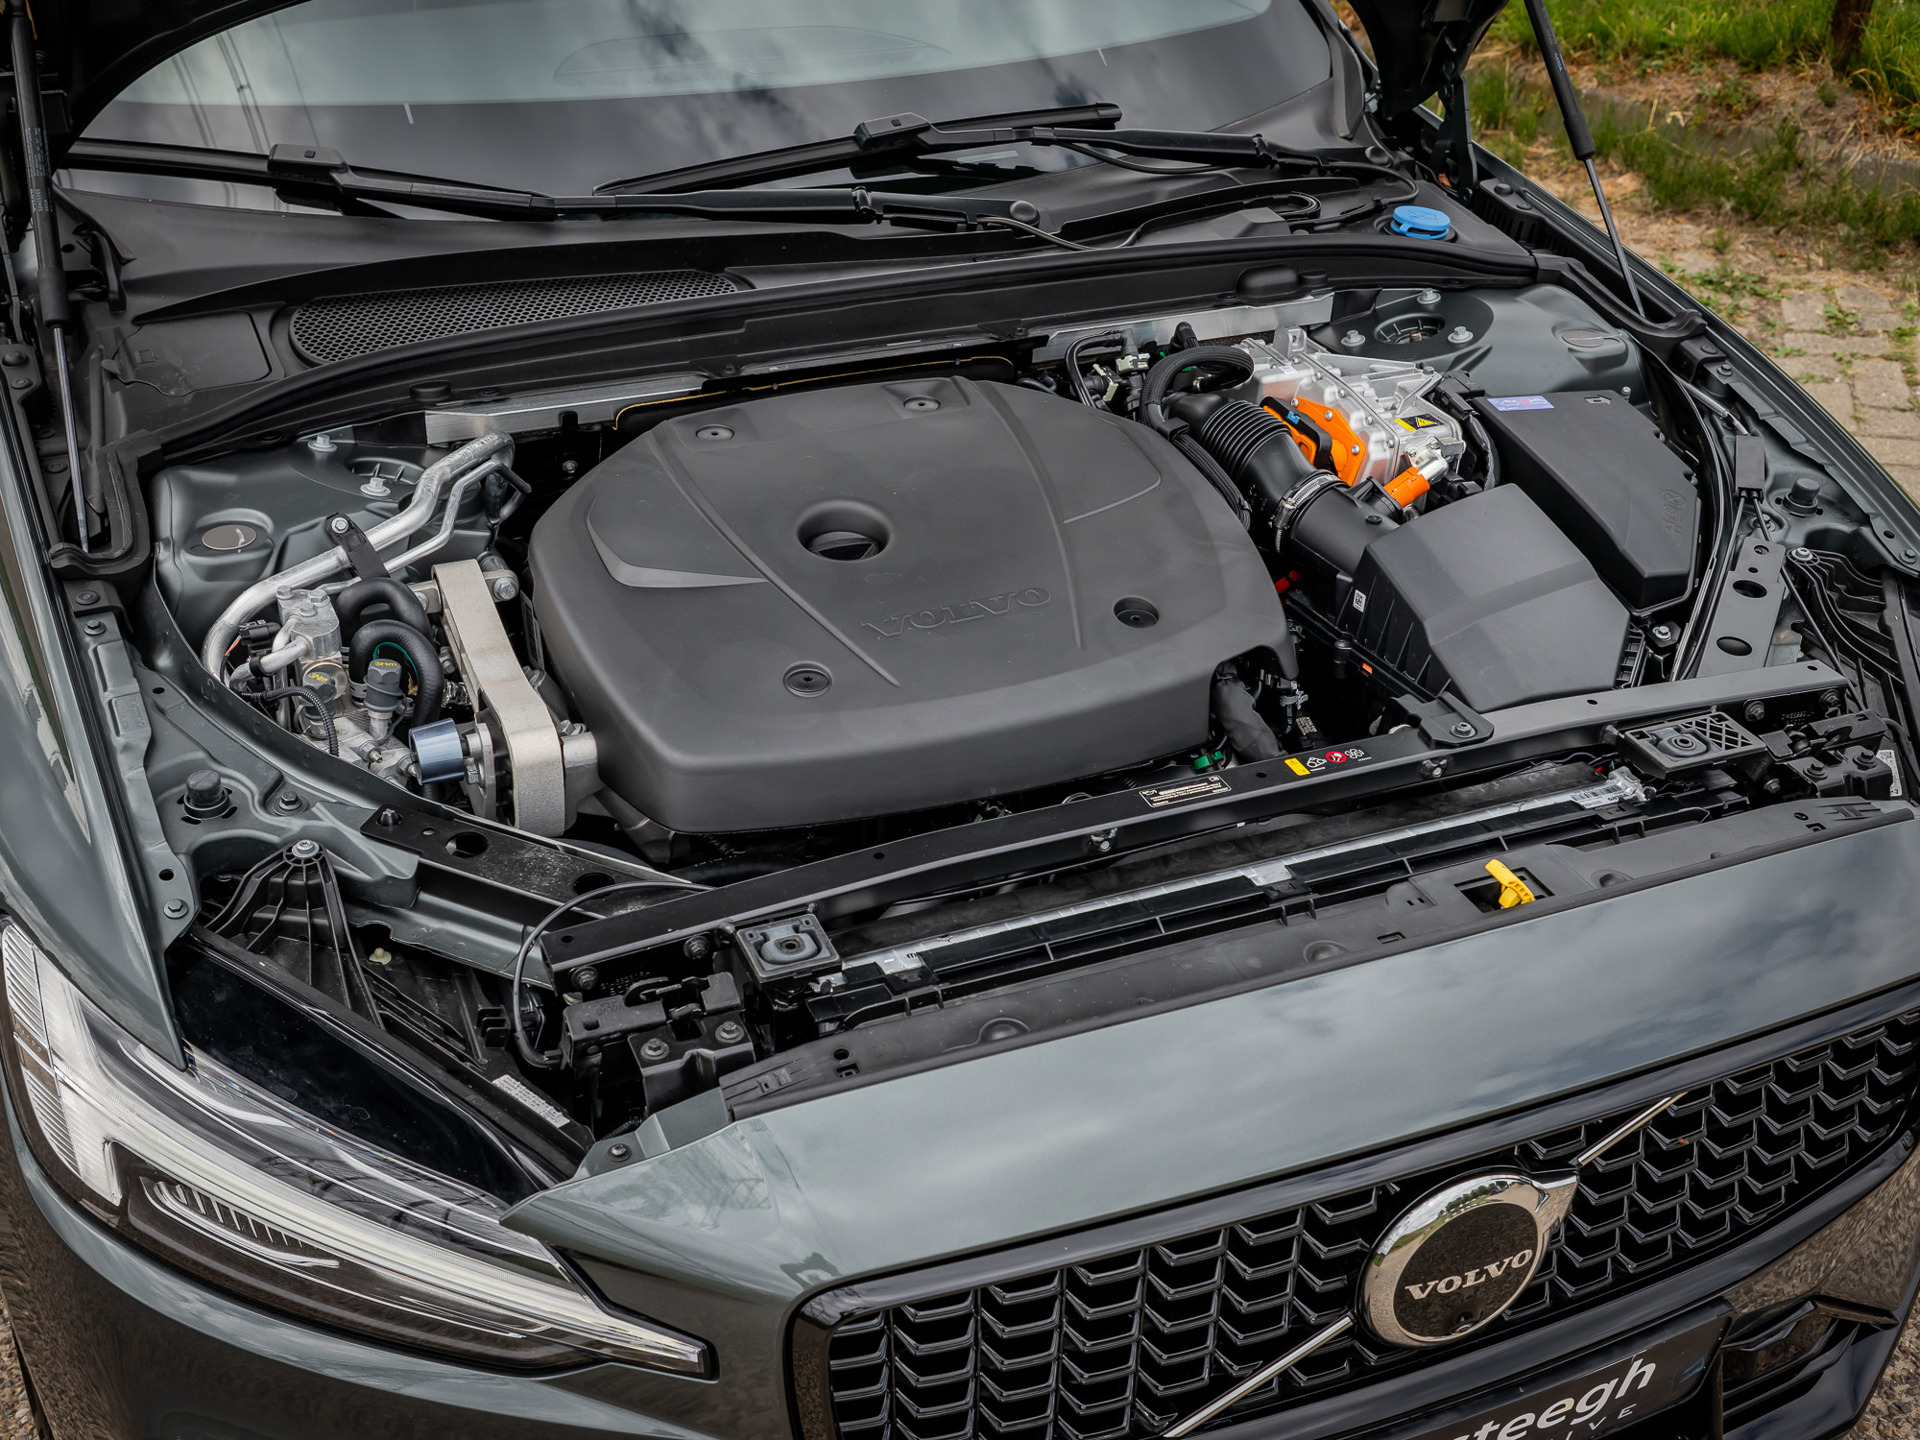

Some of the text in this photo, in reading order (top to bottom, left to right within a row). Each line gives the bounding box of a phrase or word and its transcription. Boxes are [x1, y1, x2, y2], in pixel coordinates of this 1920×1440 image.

[860, 586, 1051, 638] VOLVO
[308, 672, 329, 683] 3Nm
[1405, 1249, 1533, 1300] VOLVO
